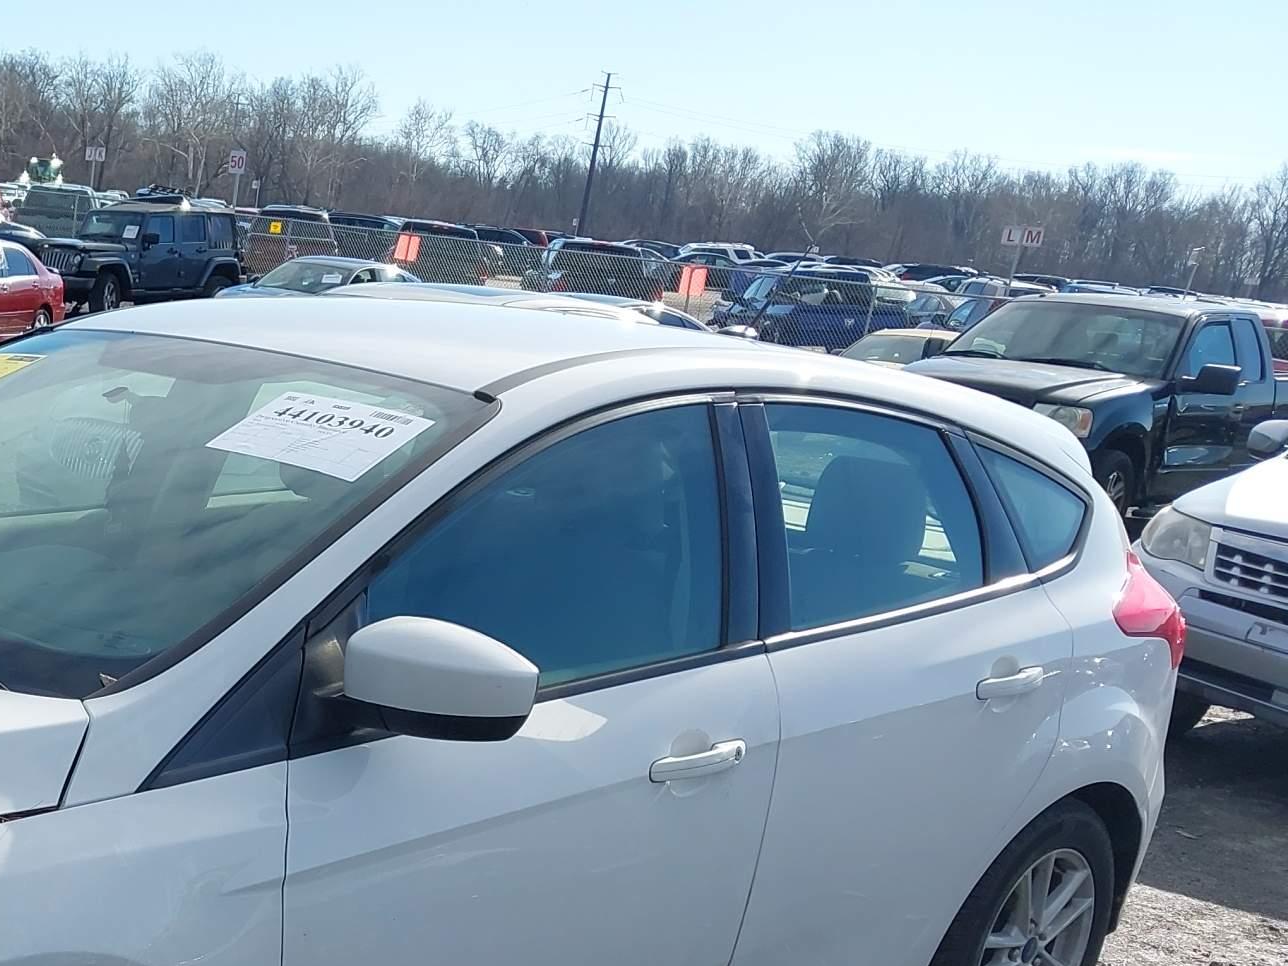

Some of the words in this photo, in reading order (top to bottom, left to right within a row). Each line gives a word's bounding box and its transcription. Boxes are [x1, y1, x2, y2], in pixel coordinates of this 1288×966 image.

[231, 155, 245, 169] 50
[1006, 229, 1015, 242] L
[1025, 230, 1042, 244] M
[273, 406, 395, 439] 44103940
